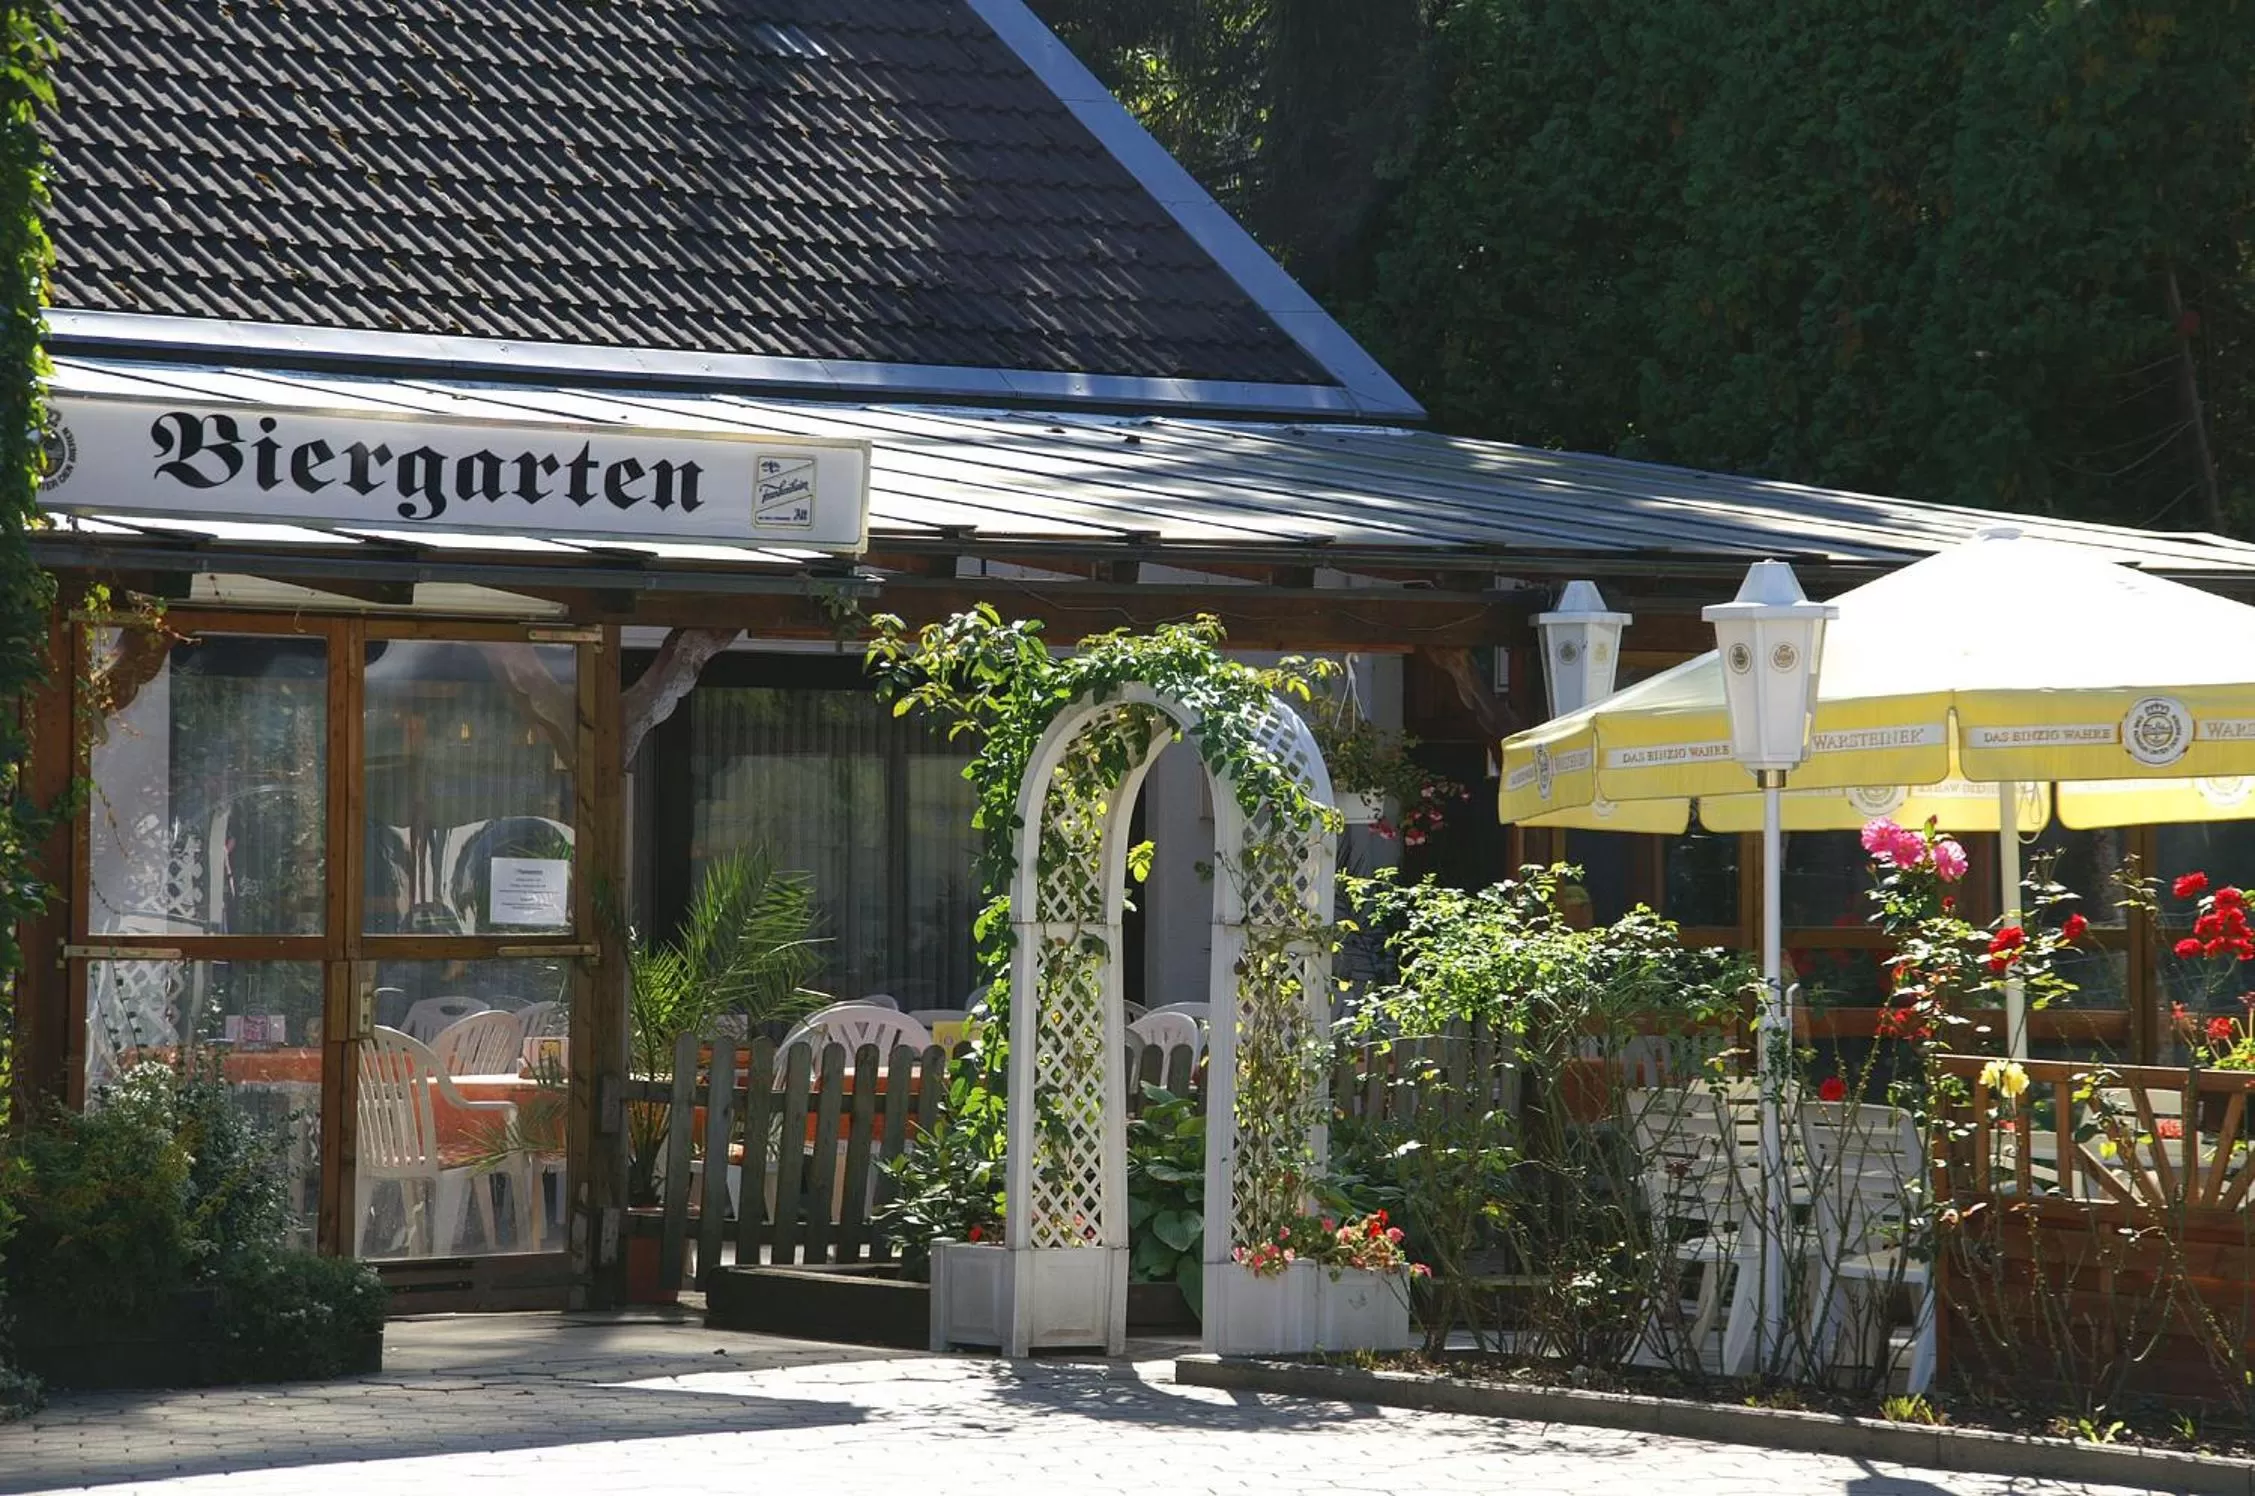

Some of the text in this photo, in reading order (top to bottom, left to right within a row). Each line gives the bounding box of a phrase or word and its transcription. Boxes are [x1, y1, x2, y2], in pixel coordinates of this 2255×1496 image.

[150, 411, 704, 520] Biergarten
[1984, 728, 2112, 743] DAS EINZIG WAHRE
[1623, 744, 1731, 763] DAS EINZIG WAHRE
